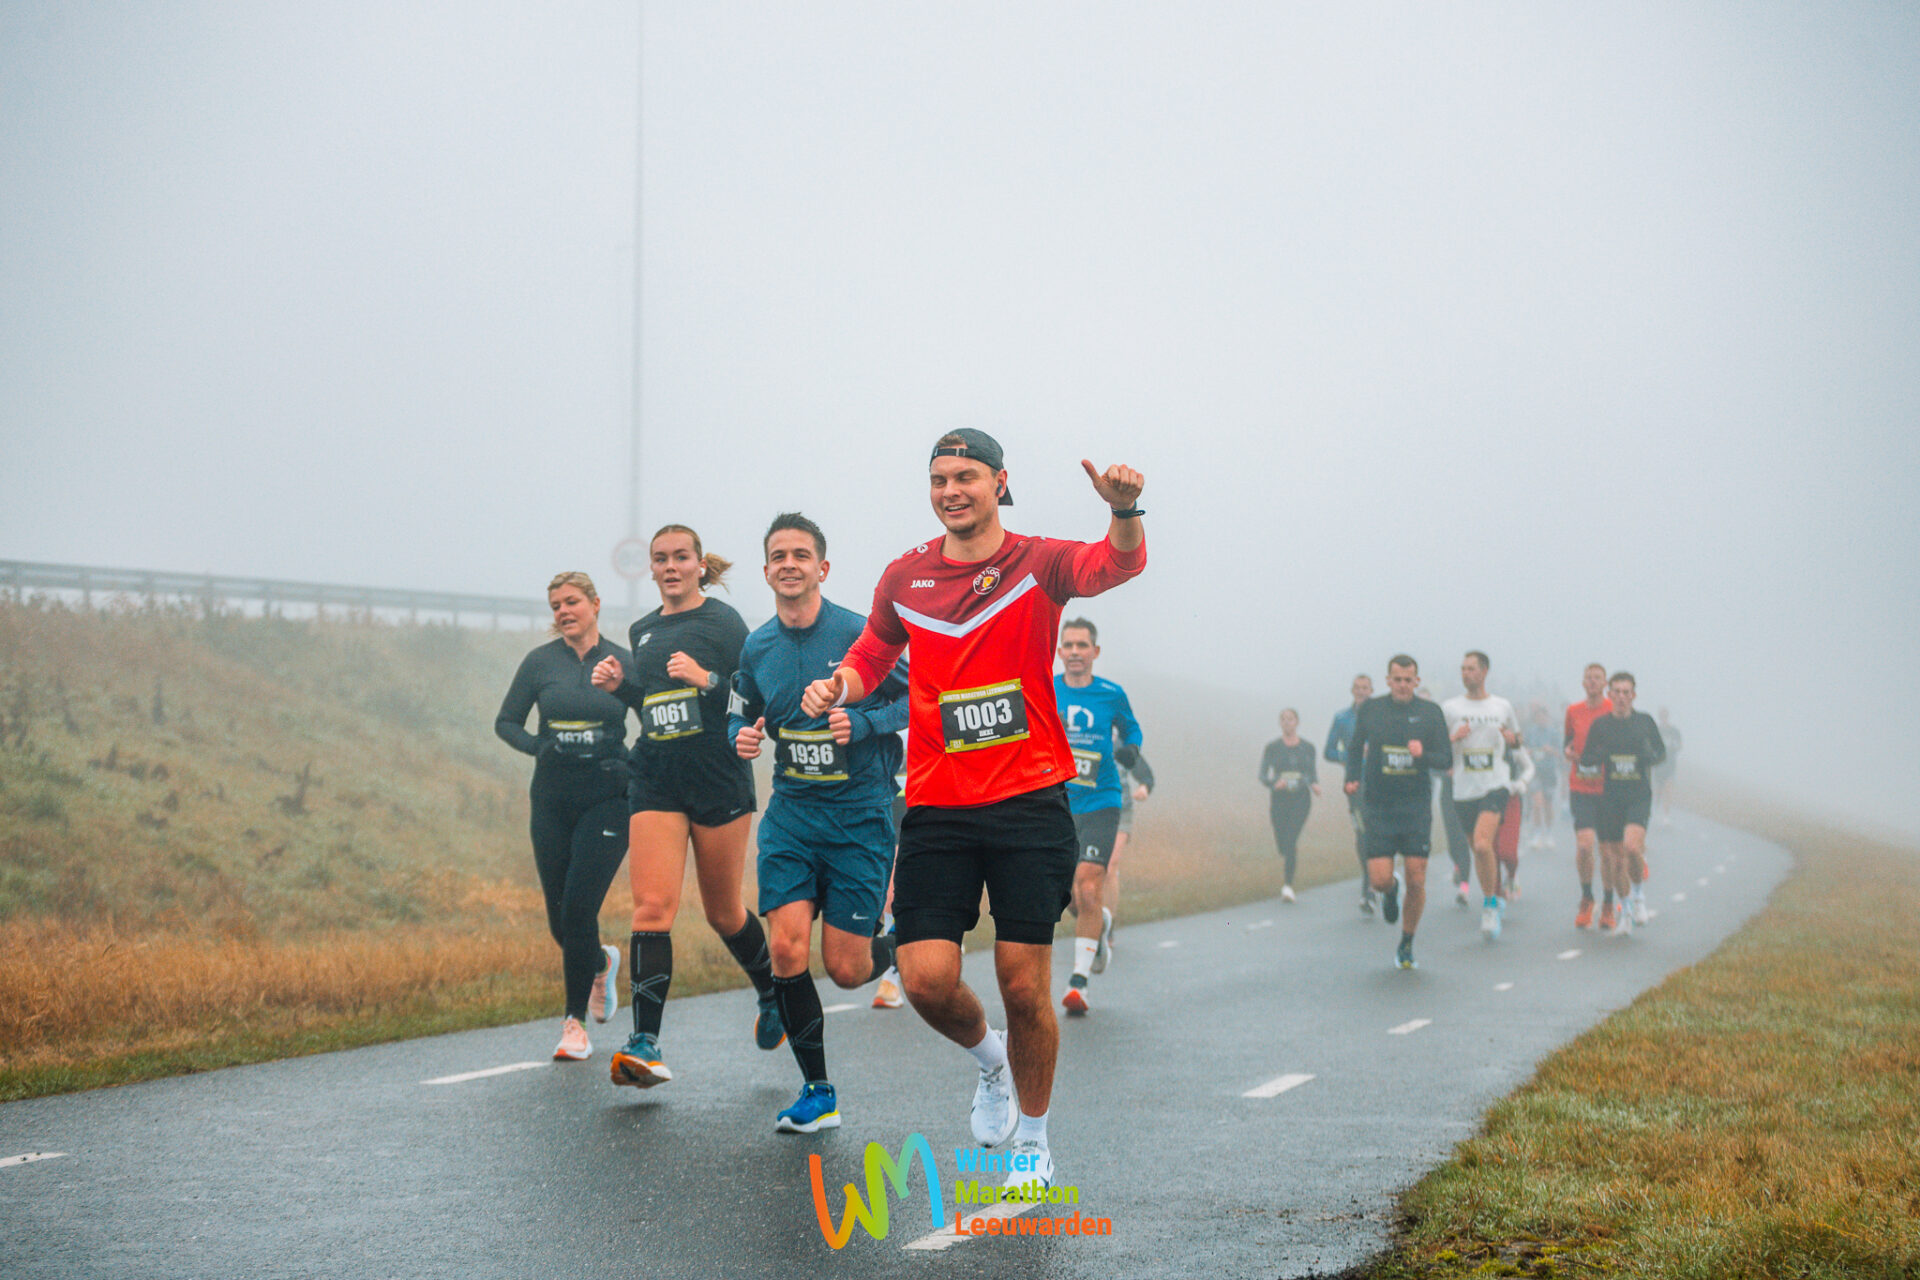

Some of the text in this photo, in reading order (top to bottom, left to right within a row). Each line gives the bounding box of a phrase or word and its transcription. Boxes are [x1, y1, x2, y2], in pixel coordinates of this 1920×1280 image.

[910, 579, 936, 589] JAKO
[650, 701, 689, 727] 1061
[953, 698, 1013, 731] 1003
[788, 743, 835, 766] 1936
